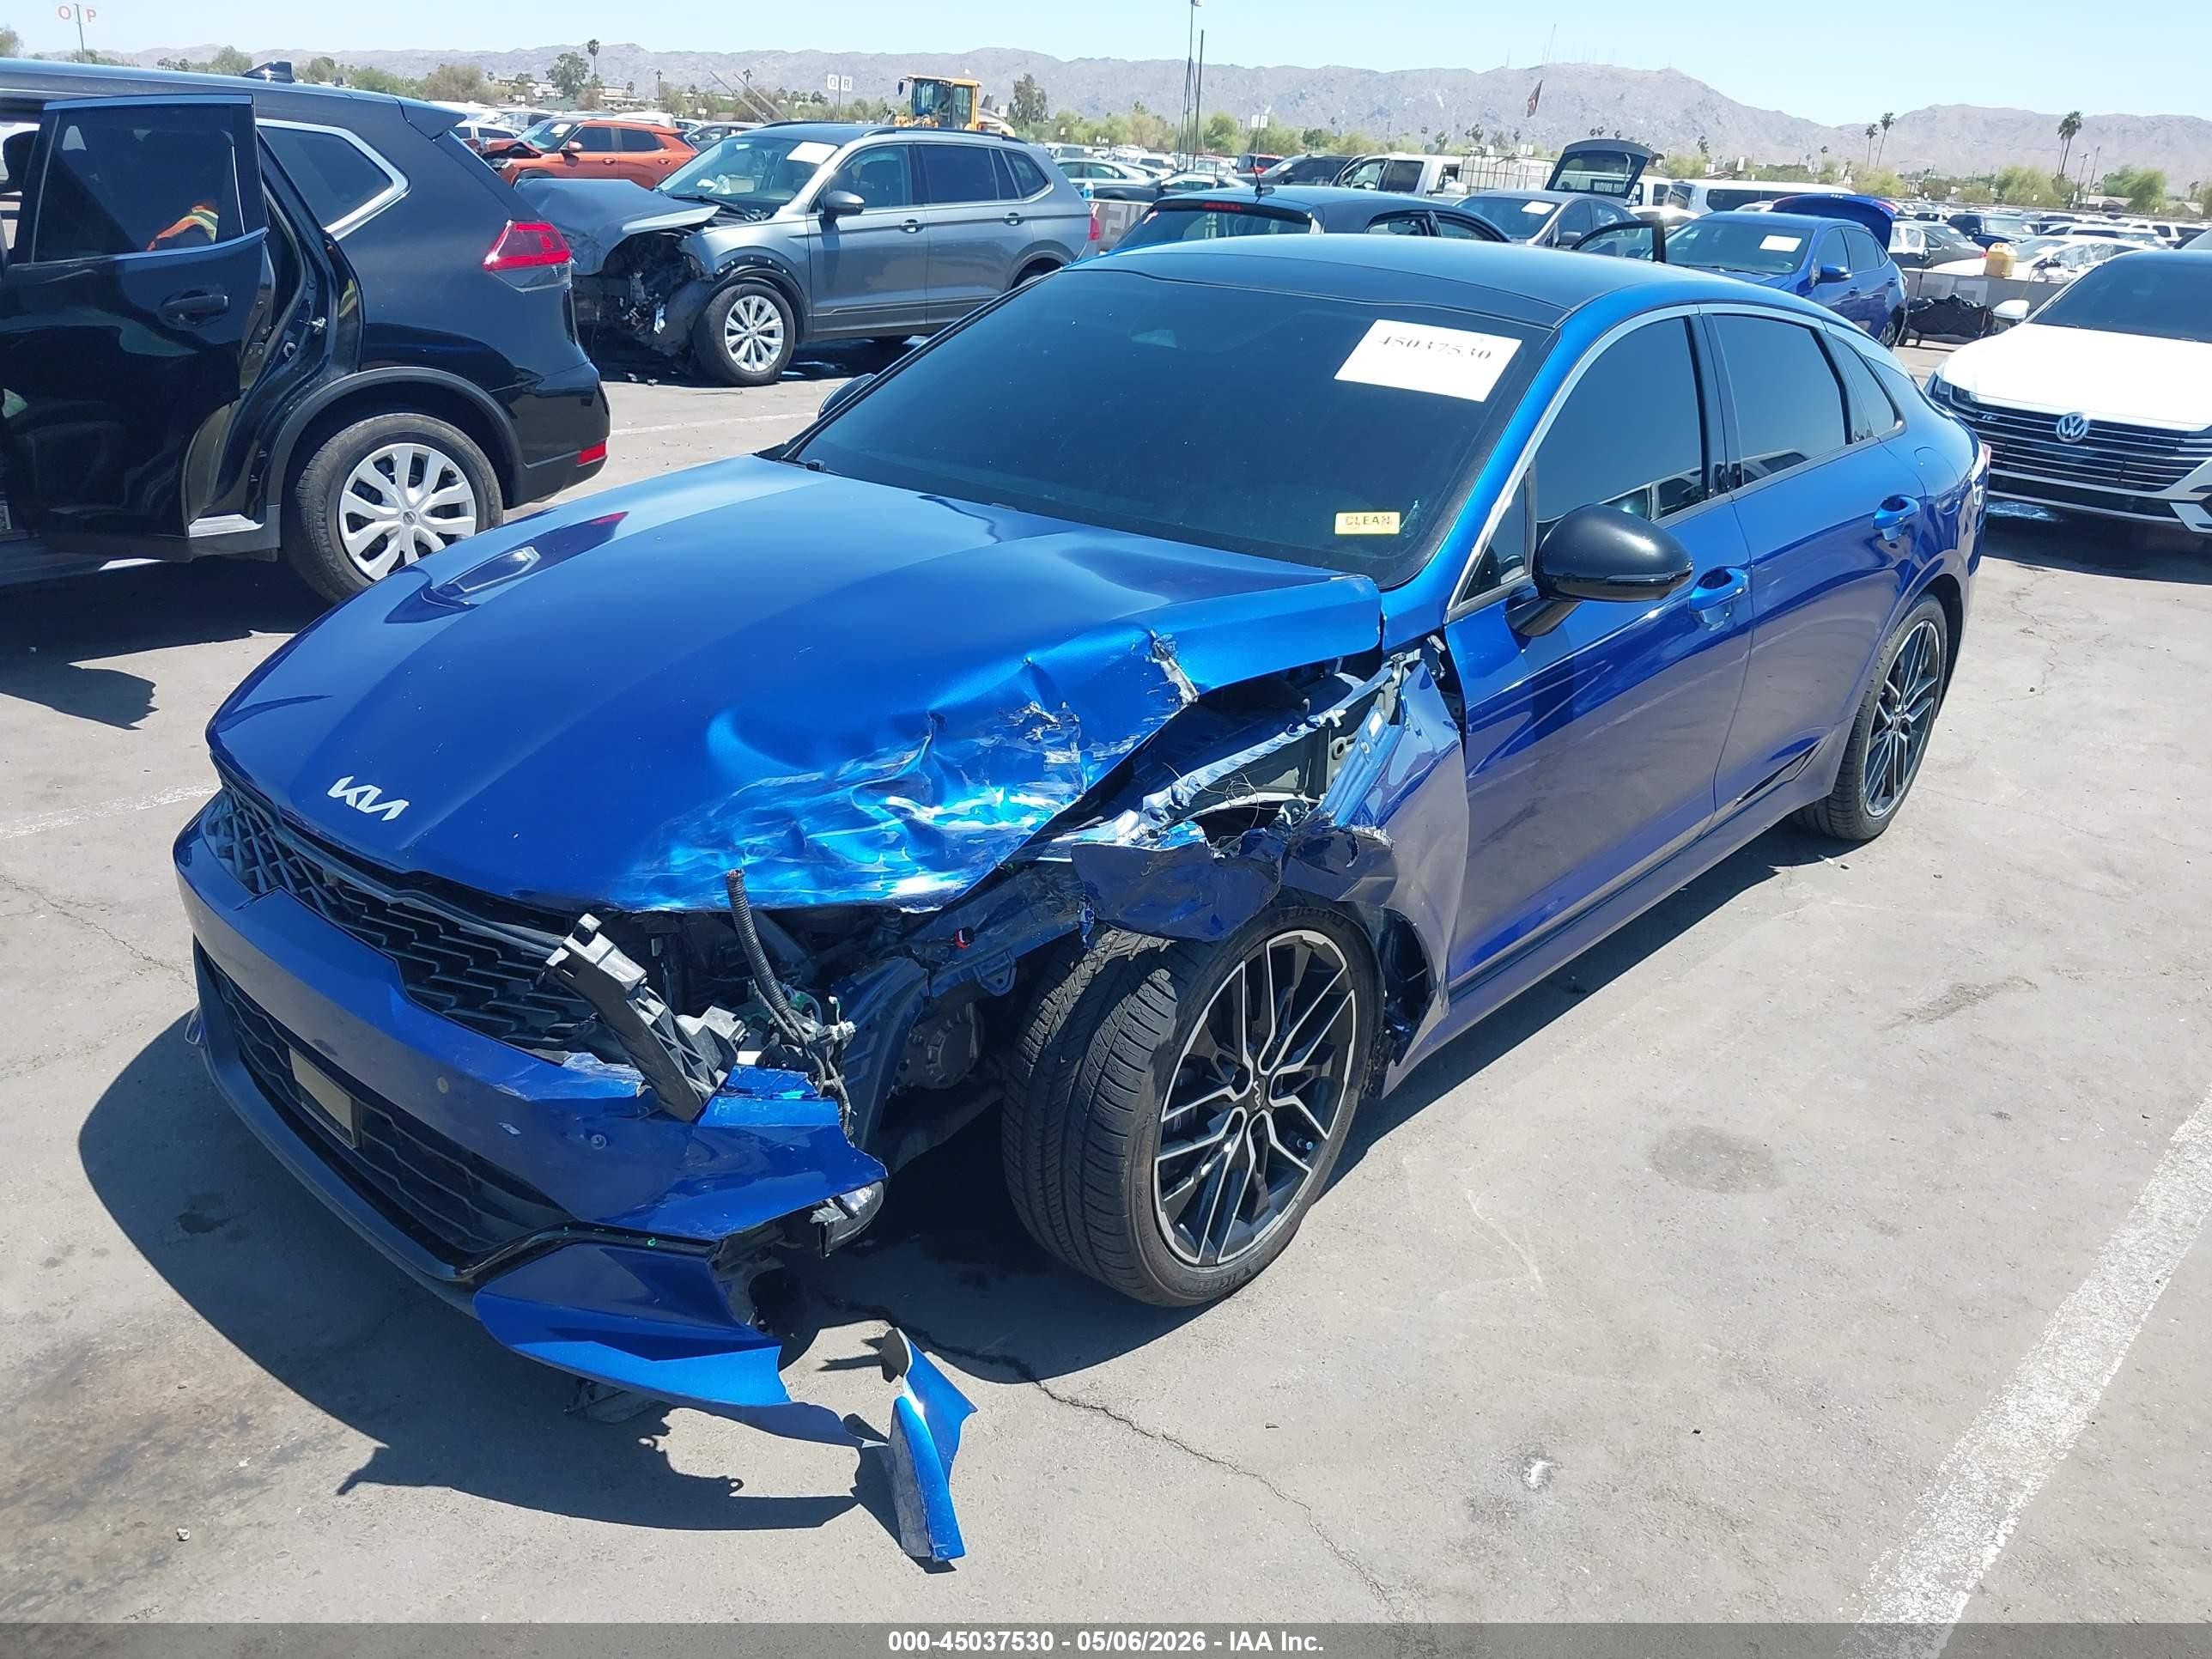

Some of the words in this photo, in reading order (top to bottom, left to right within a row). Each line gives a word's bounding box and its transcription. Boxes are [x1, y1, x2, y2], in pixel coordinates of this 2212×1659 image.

[58, 5, 71, 20] O
[87, 9, 96, 22] P
[1378, 336, 1492, 360] 45037530
[1345, 515, 1391, 526] CLEAN
[327, 775, 410, 821] KIA
